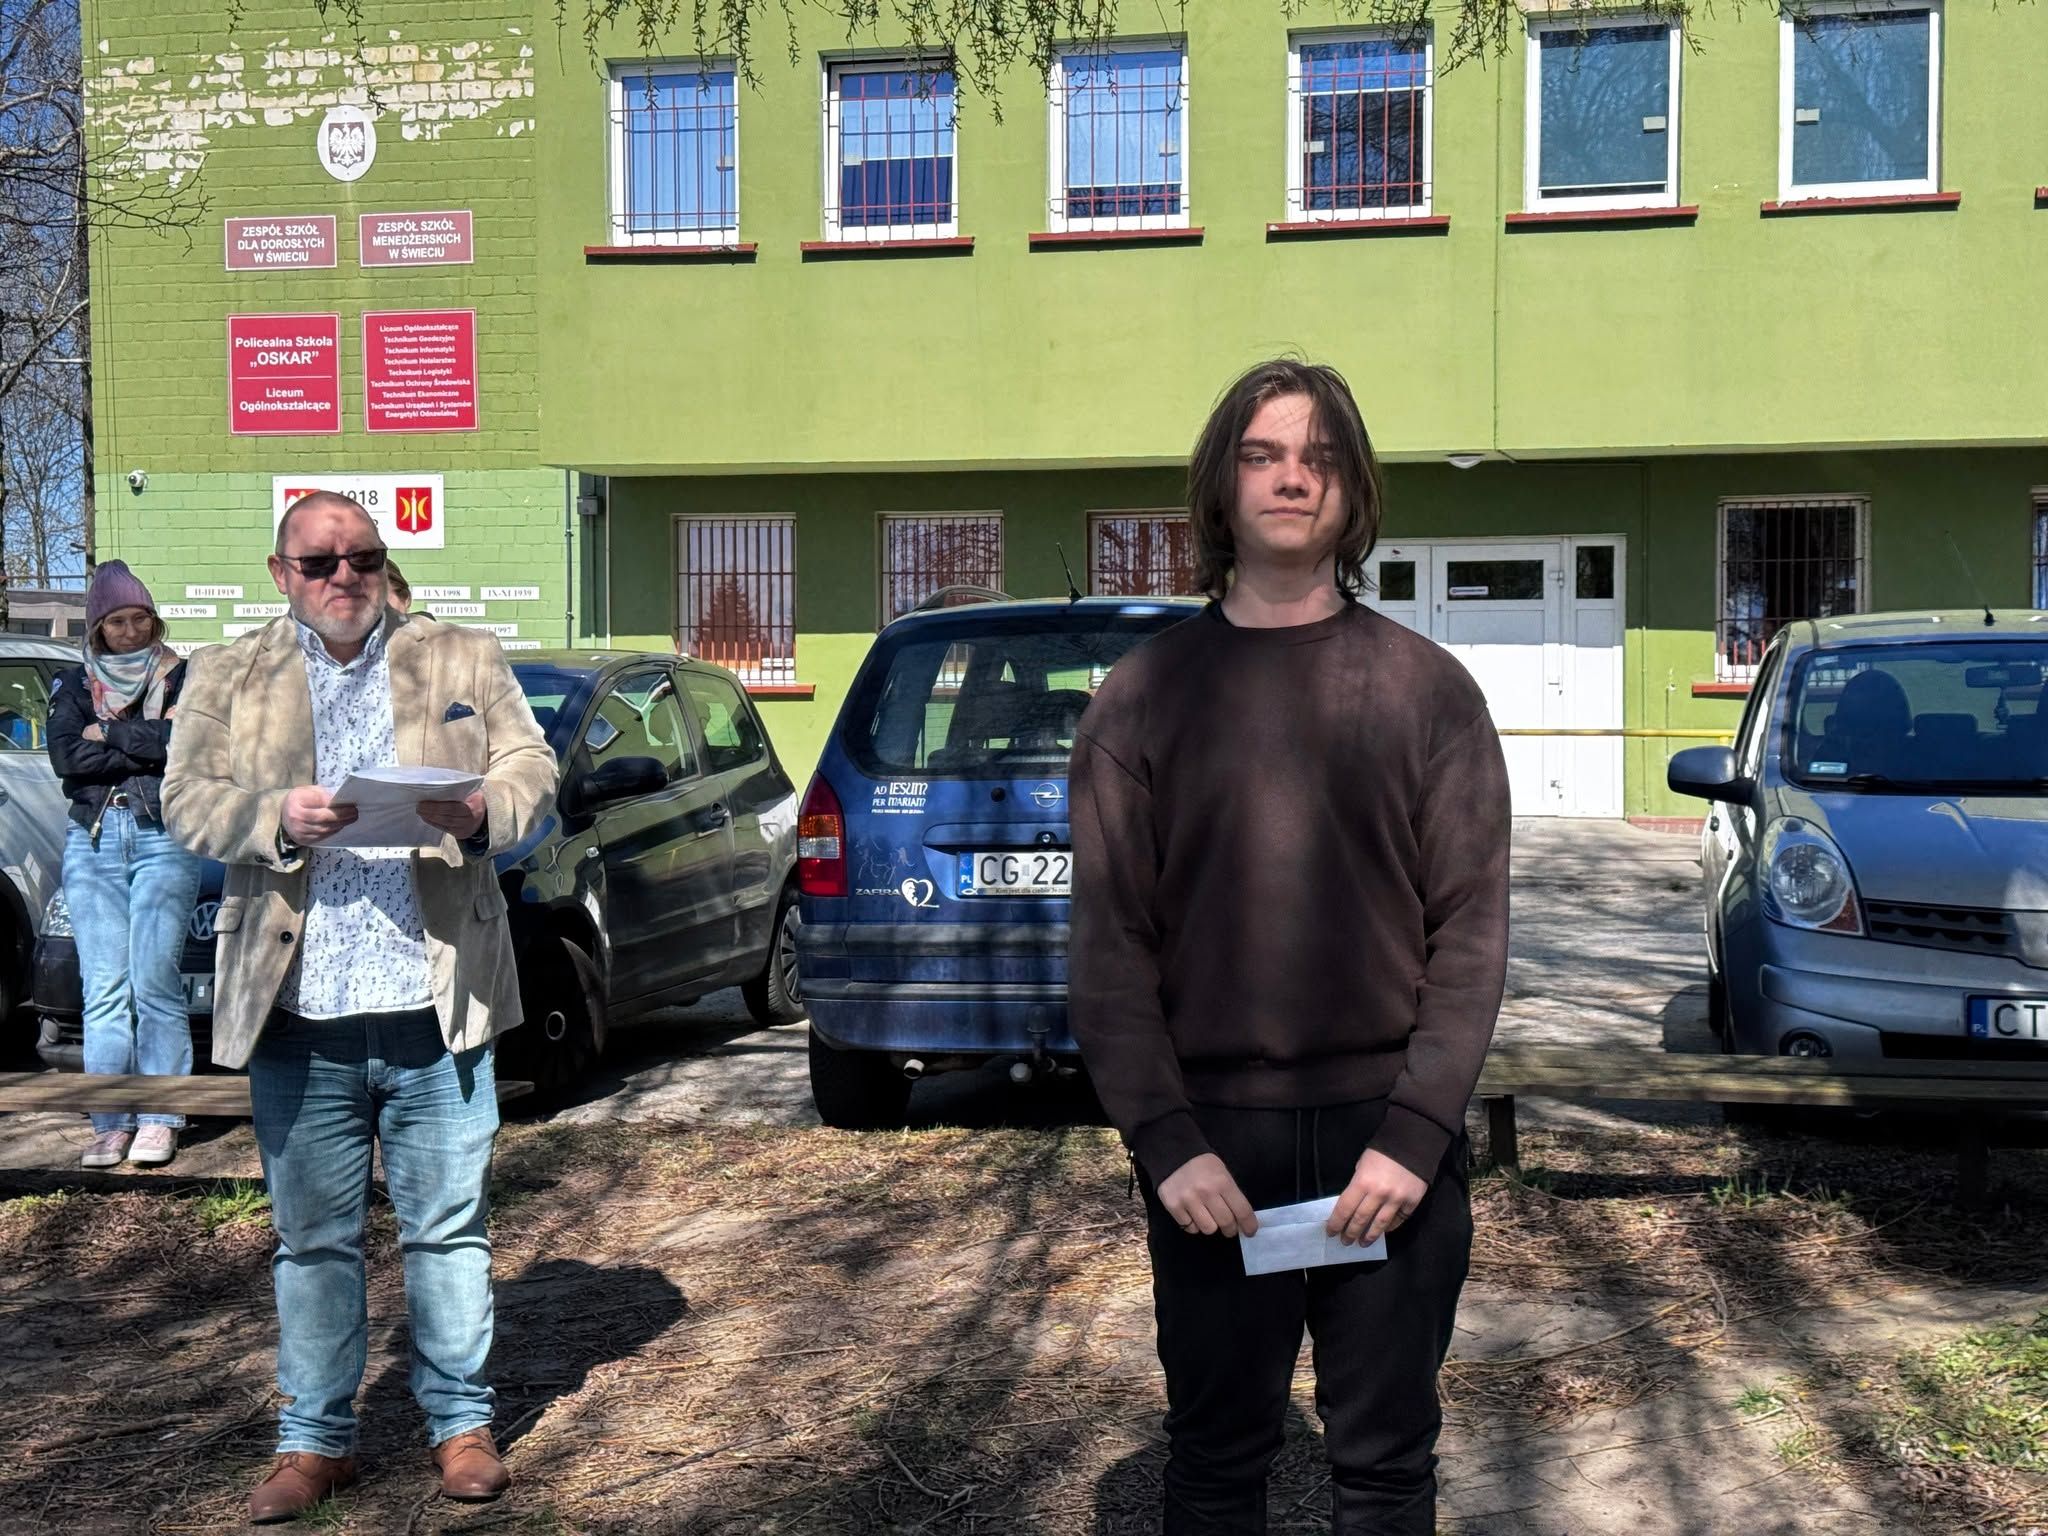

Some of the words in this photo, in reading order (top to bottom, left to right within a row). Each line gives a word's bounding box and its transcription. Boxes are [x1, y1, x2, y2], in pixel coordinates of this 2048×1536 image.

[242, 224, 283, 237] ZESPÓŁ
[285, 222, 320, 236] SZKÓŁ
[377, 219, 419, 233] ZESPÓŁ
[421, 217, 456, 231] SZKÓŁ
[237, 240, 259, 250] DLA
[261, 238, 325, 250] DOROSŁYCH
[372, 233, 461, 246] MENEDŻERSKICH
[254, 252, 264, 263] W
[266, 250, 309, 262] ŚWIECIU
[389, 248, 399, 259] W
[401, 246, 445, 259] ŚWIECIU
[380, 325, 403, 333] Liceum
[235, 337, 293, 348] Policealna
[295, 336, 333, 347] Szkoła
[384, 336, 418, 344] Technikum
[370, 380, 404, 388] Technikum
[266, 388, 304, 398] Liceum
[240, 401, 331, 413] Ogólnokształcące
[370, 402, 404, 410] Technikum
[217, 588, 235, 596] 1919
[874, 785, 888, 795] AD
[872, 798, 887, 807] PER
[961, 875, 972, 883] PL
[980, 855, 1019, 885] CG
[1032, 855, 1069, 885] 22
[855, 888, 901, 896] ZAFIRA
[1973, 1023, 1987, 1033] PL
[1994, 1003, 2046, 1038] CT
